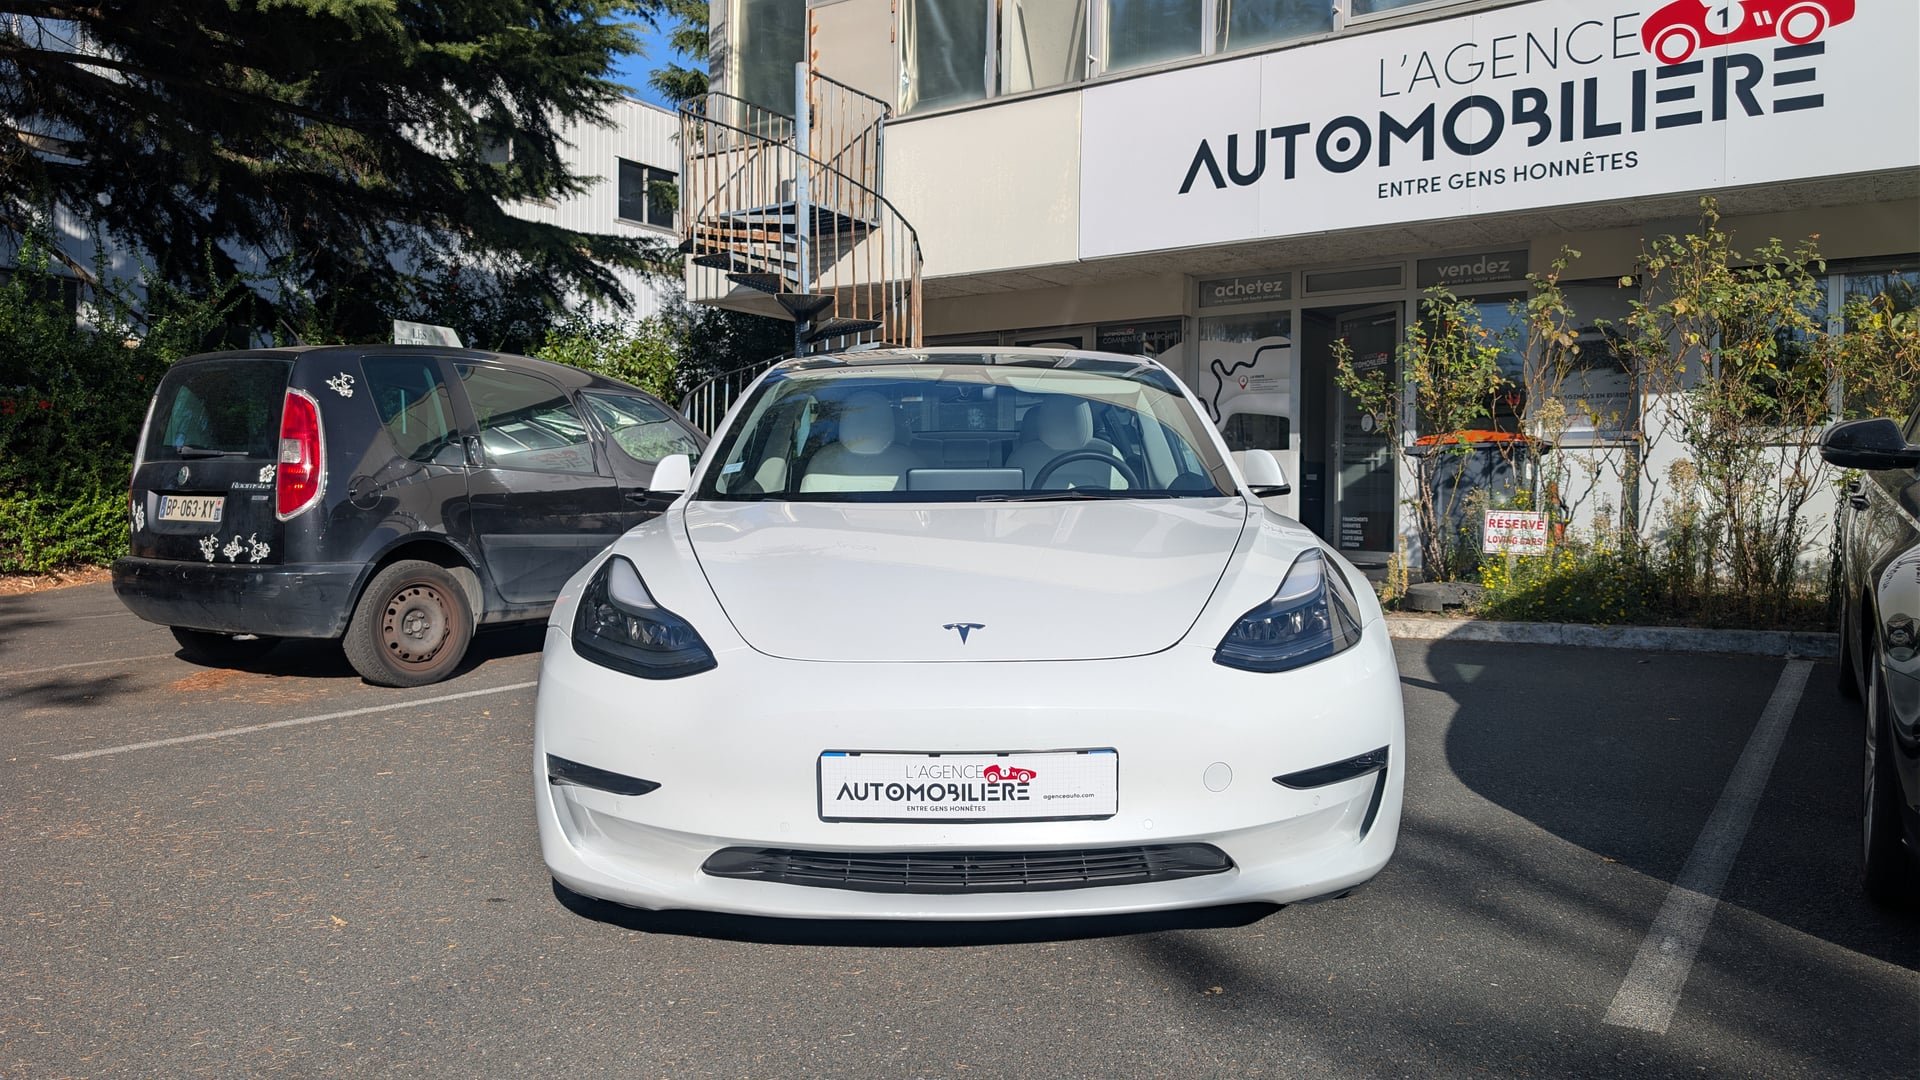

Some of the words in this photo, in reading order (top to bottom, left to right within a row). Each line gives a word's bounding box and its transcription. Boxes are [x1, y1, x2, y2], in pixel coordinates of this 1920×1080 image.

[1380, 12, 1641, 98] L'AGENCE
[1378, 177, 1442, 199] ENTRE
[1448, 169, 1506, 191] GENS
[1513, 151, 1639, 183] HONNÊTES
[1437, 255, 1511, 278] vendez
[1215, 279, 1283, 297] achetez
[1102, 334, 1136, 344] COMMENT
[1487, 535, 1518, 545] LOVING
[1519, 537, 1543, 546] CARS
[1042, 791, 1095, 801] agenceauto.com
[949, 803, 986, 812] HONNÊTES
